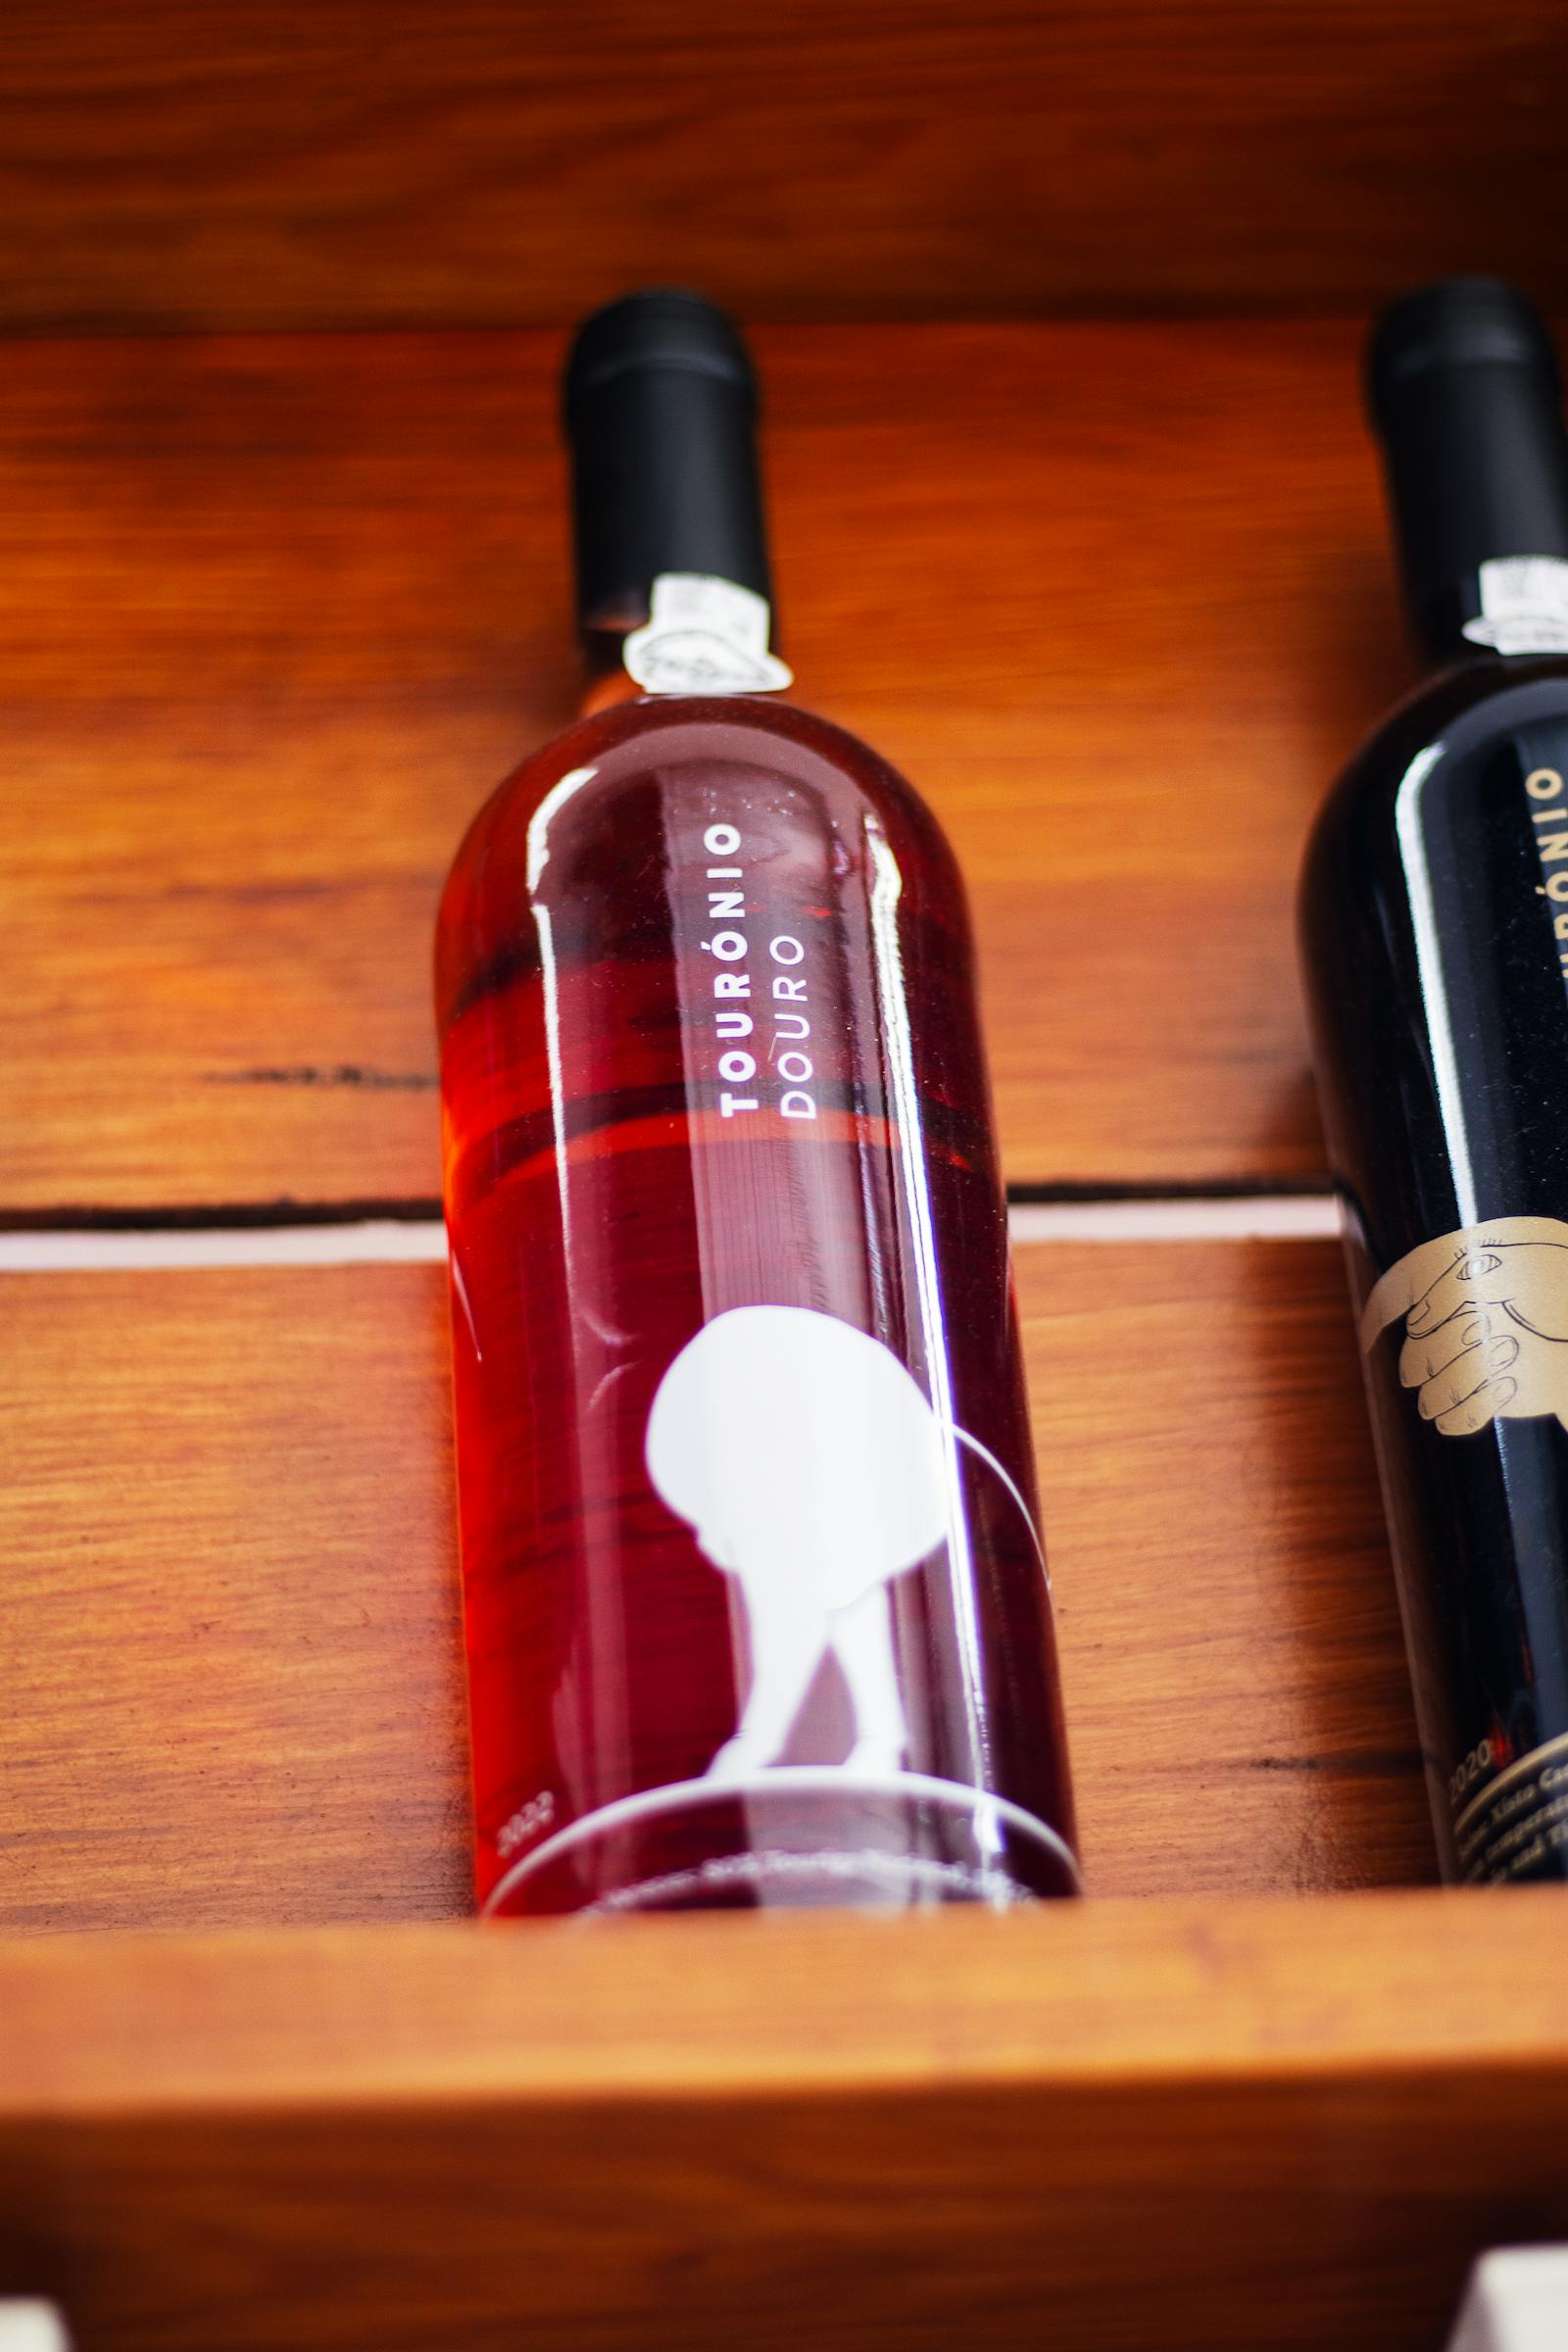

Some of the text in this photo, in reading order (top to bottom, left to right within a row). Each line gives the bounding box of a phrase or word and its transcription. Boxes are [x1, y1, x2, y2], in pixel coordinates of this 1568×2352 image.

[700, 823, 759, 1118] TOURÓNIO
[1526, 767, 1568, 979] ÓNIO
[769, 934, 816, 1119] DOURO
[1447, 1738, 1492, 1807] 2020
